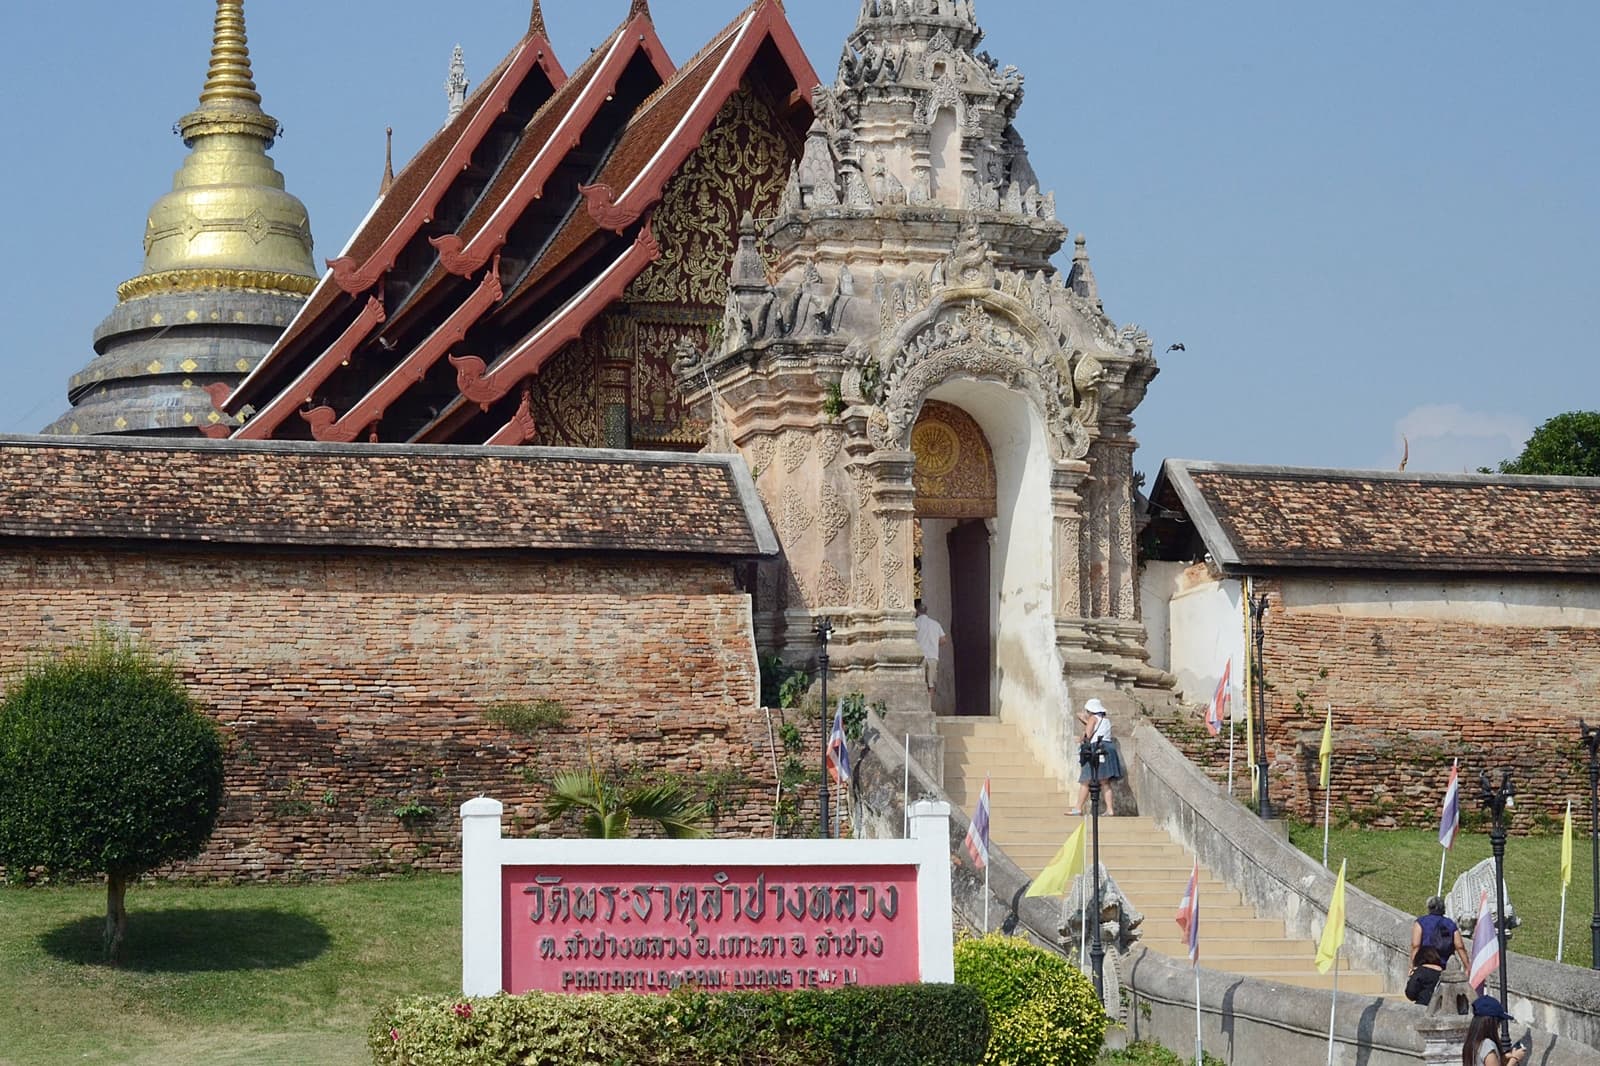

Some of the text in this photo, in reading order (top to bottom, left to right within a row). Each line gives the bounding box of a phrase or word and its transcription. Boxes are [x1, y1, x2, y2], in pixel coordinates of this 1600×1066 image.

[523, 871, 899, 935] วัดพระธาตุลำปางหลวง
[815, 927, 885, 958] ลำปาง
[734, 968, 793, 988] LUANG
